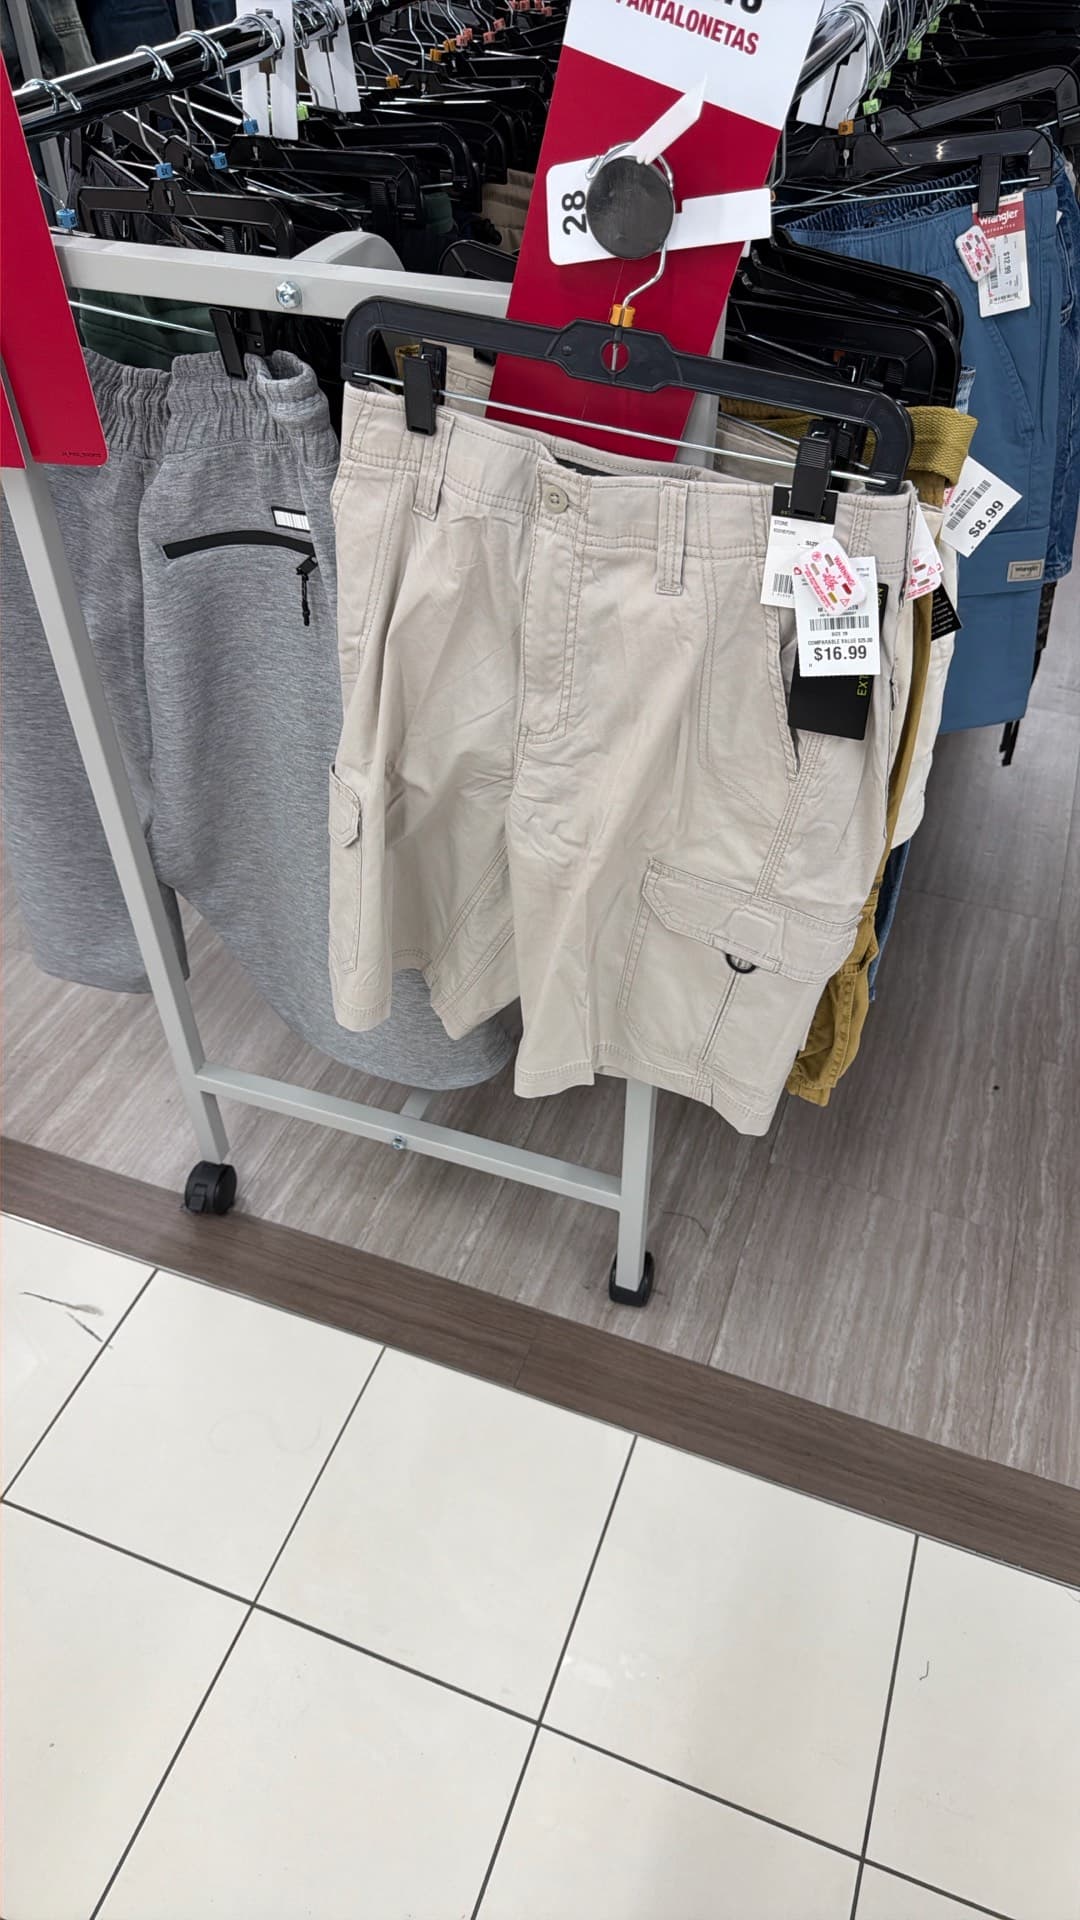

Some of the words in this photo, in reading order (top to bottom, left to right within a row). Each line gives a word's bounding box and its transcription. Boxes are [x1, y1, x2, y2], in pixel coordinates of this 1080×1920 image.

[615, 0, 759, 55] ANTALONETAS
[561, 190, 587, 235] 28
[968, 500, 1004, 538] $8.99
[814, 645, 867, 662] $16.99
